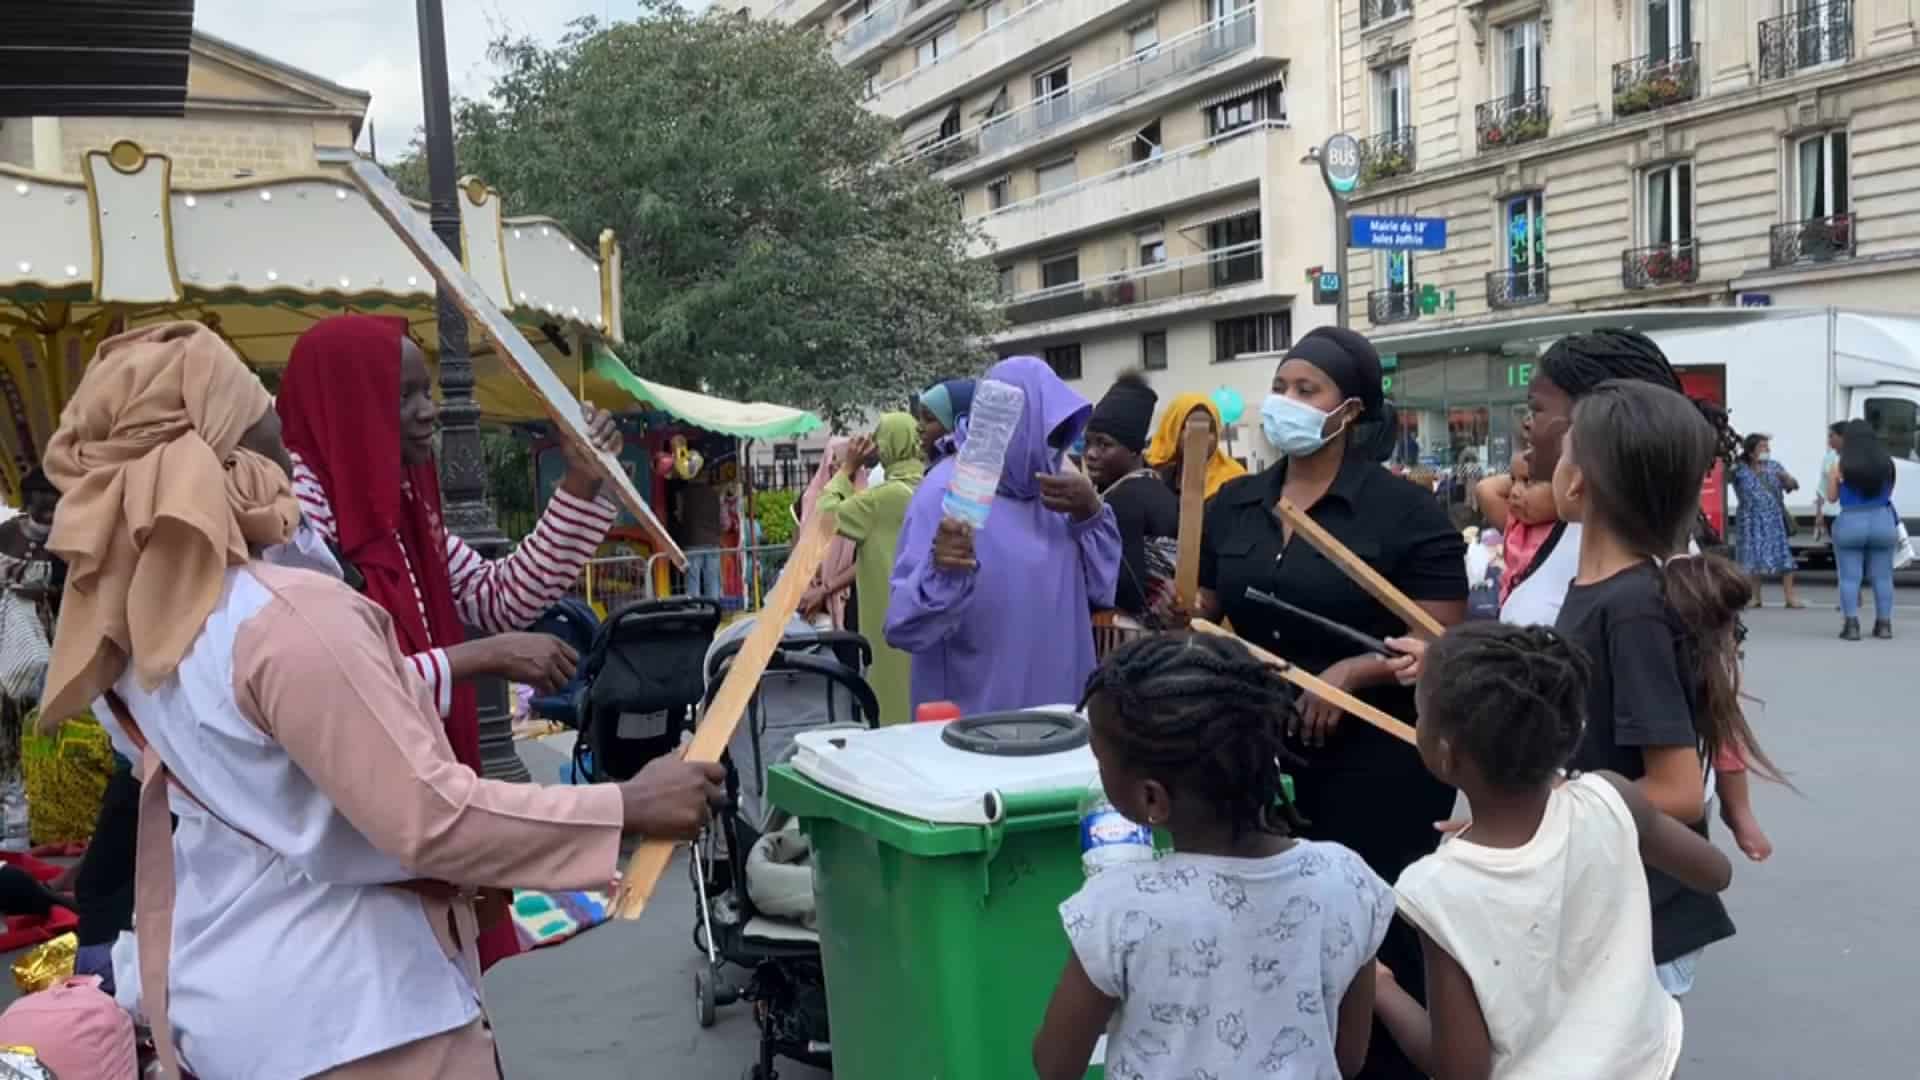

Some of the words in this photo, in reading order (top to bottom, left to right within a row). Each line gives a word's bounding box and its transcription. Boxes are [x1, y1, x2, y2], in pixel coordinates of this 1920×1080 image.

[1328, 148, 1356, 167] BUS
[1370, 220, 1398, 232] Mairie
[1400, 221, 1412, 233] du
[1372, 232, 1393, 244] Jules
